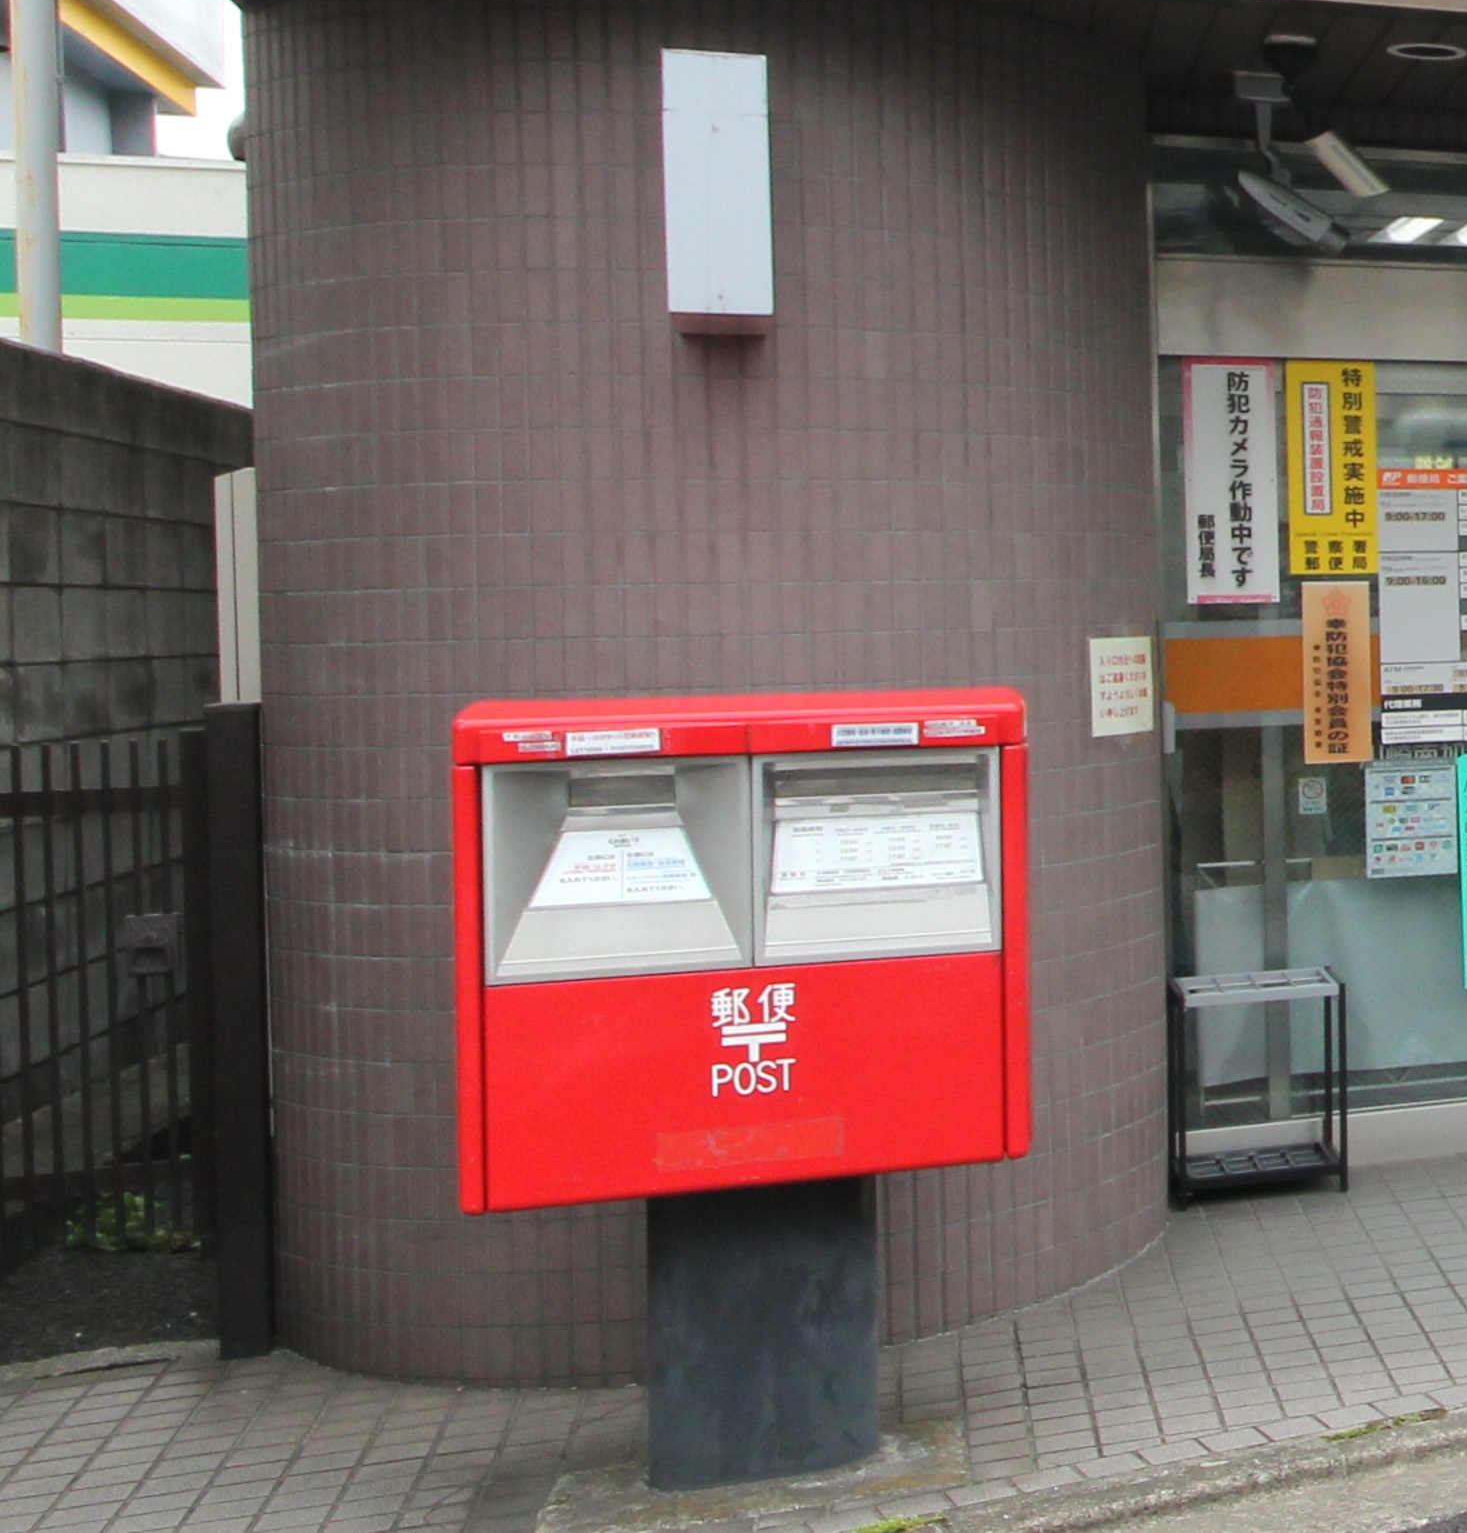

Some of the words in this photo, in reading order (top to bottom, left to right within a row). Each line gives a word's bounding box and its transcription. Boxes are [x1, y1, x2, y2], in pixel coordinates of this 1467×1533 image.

[1341, 368, 1365, 528] 特別警戒実施中
[1226, 371, 1254, 588] 防犯カメラ作動中です
[1385, 511, 1445, 521] 9:00-17:00
[1197, 513, 1216, 579] 郵便局長
[1304, 556, 1368, 571] 郵便局
[710, 982, 797, 1027] 郵便
[711, 1058, 797, 1097] POST
